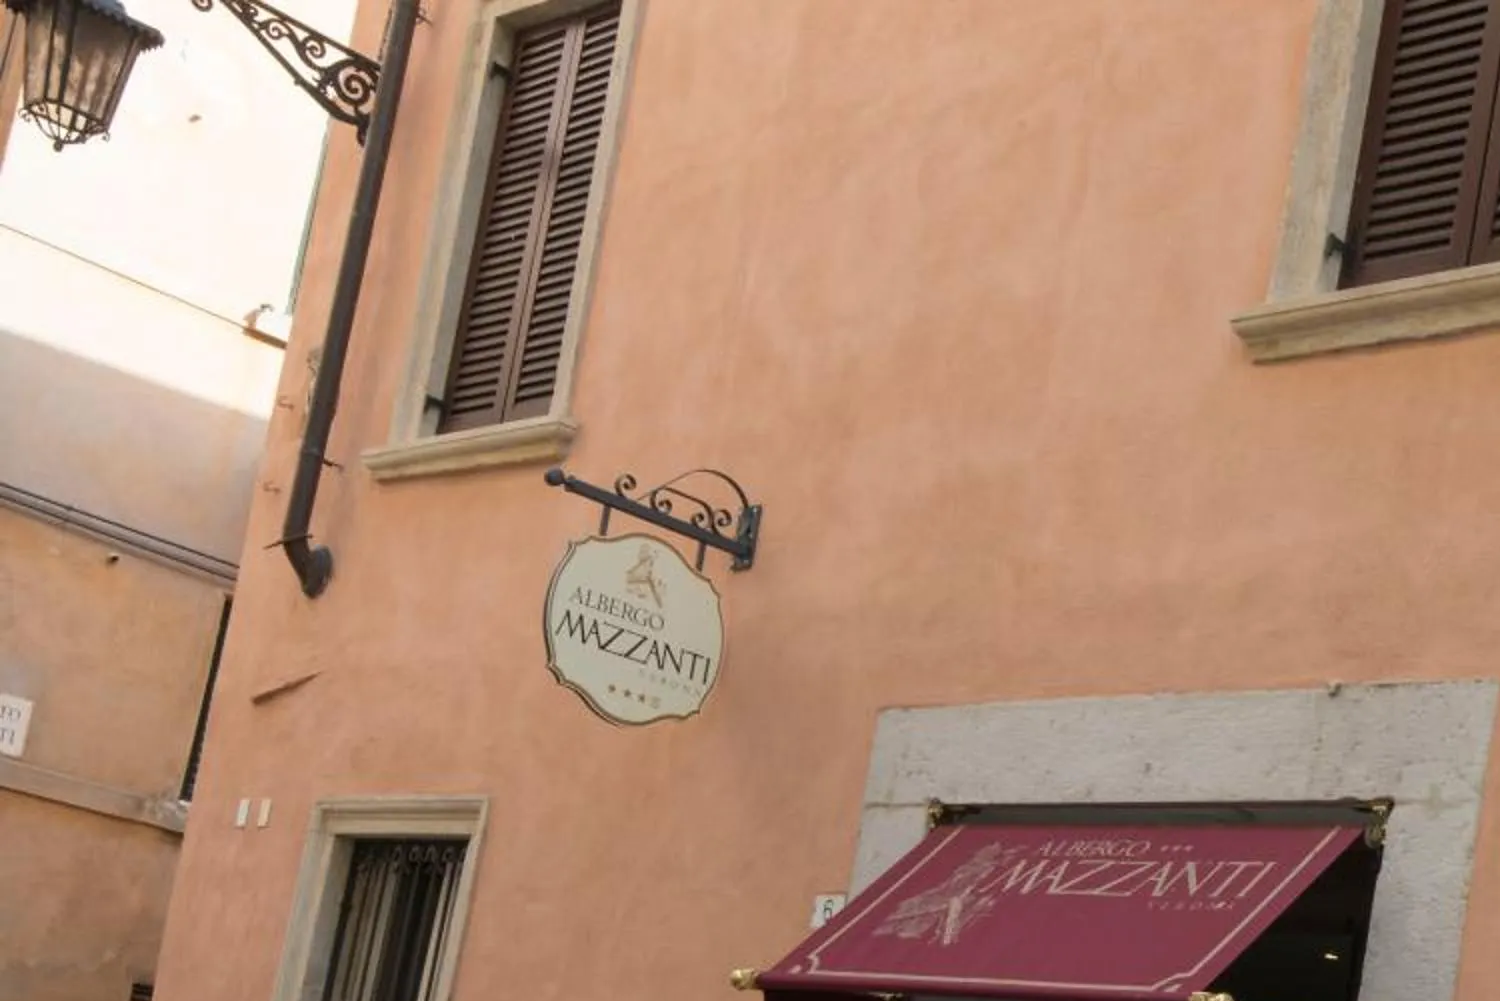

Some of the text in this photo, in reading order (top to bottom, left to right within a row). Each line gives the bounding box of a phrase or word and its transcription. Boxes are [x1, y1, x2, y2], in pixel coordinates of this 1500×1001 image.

[570, 586, 664, 631] ALBERGO
[555, 609, 711, 685] MAZZANTI
[1038, 838, 1151, 857] ALBERGO
[980, 859, 1277, 897] MAZZANTI
